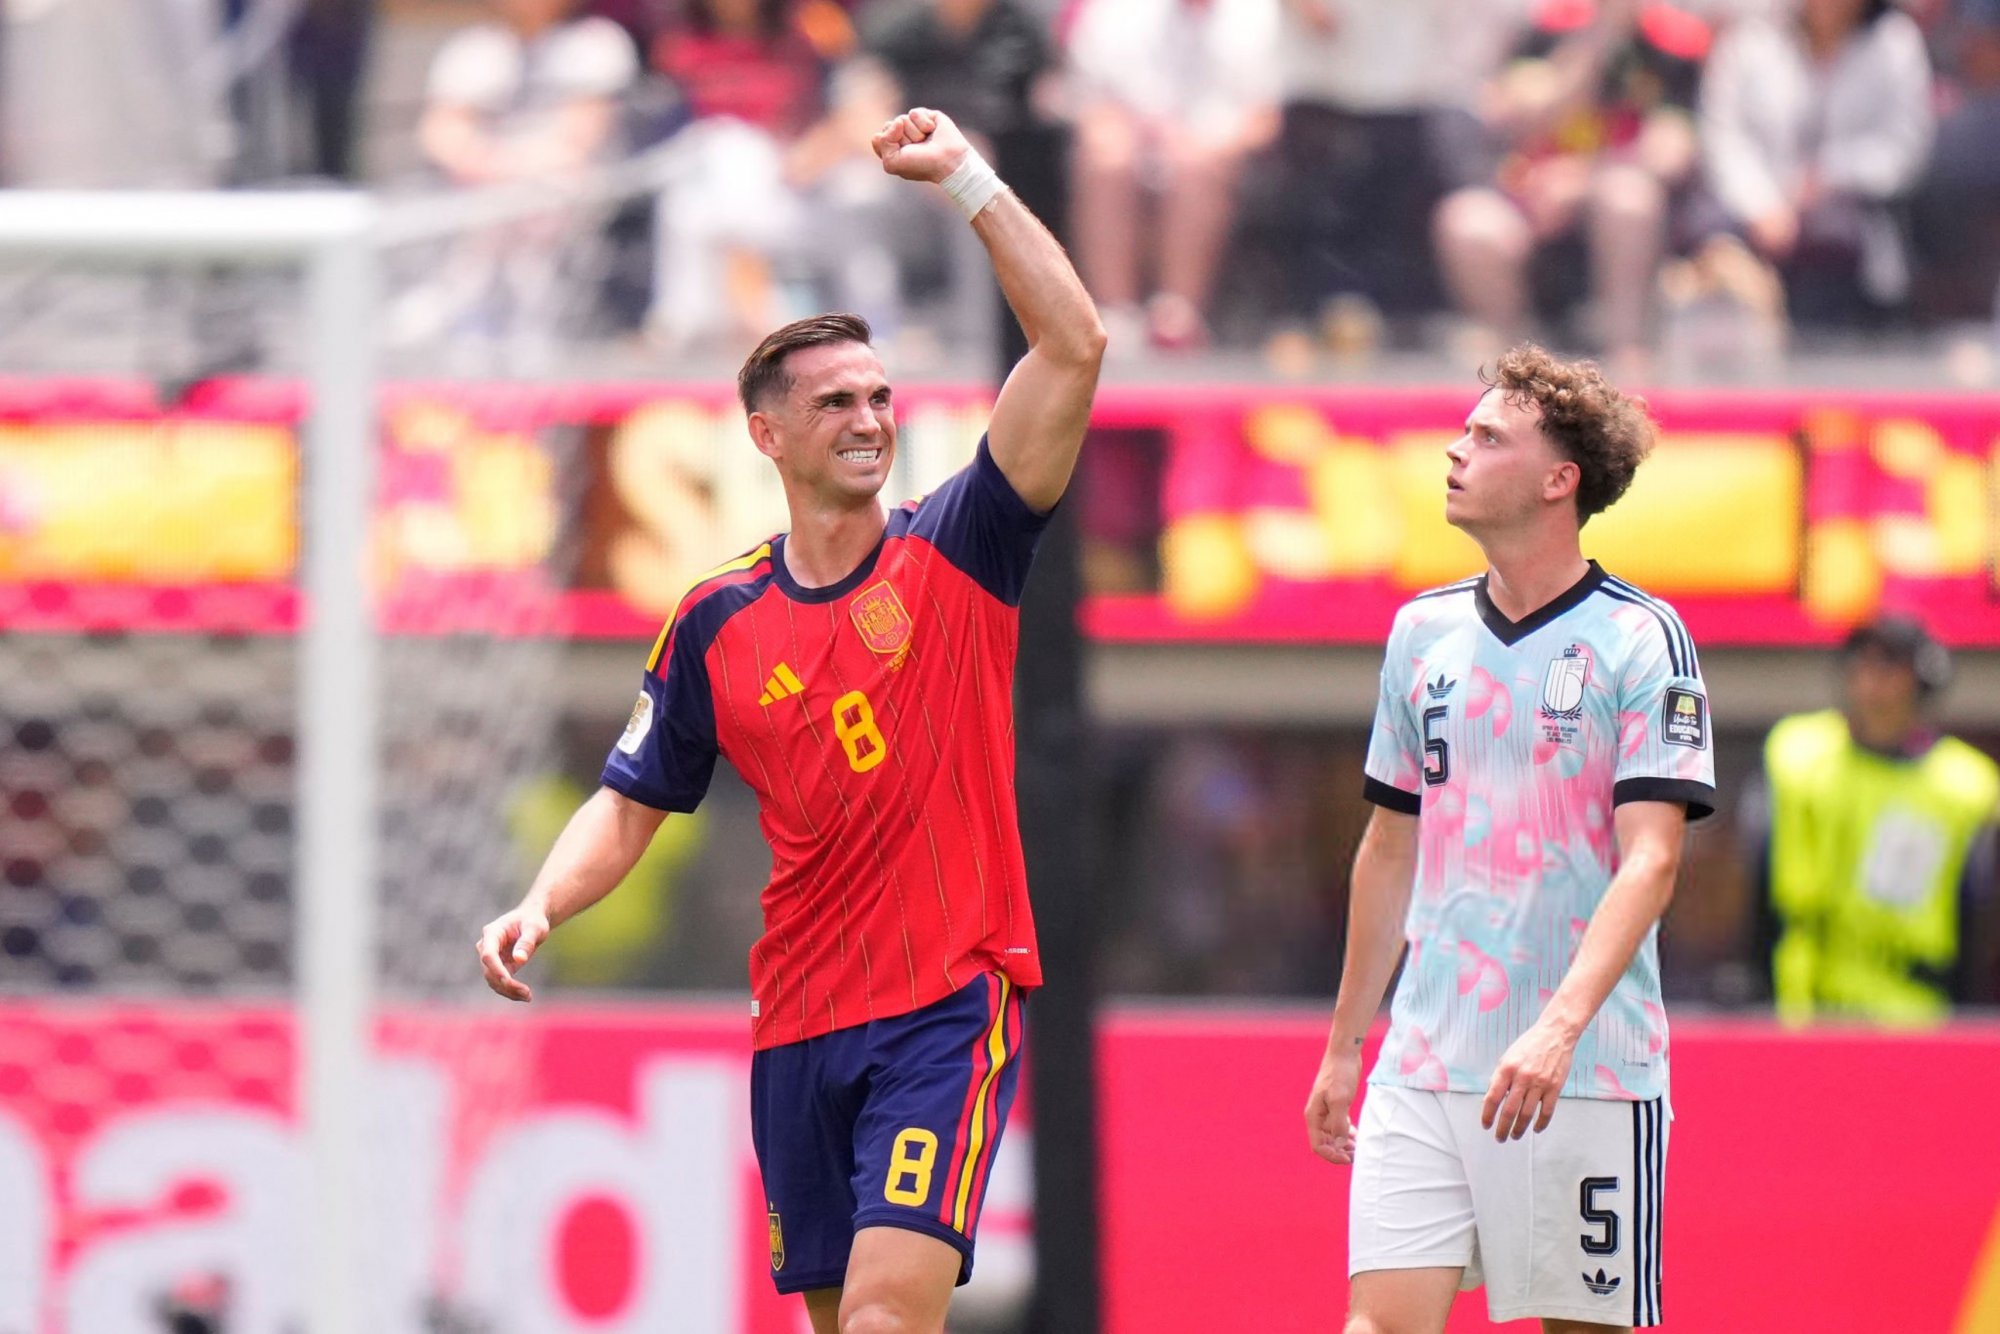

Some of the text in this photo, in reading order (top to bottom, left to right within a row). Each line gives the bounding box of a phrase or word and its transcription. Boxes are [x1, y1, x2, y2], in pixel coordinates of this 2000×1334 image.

[832, 690, 886, 773] 8
[1423, 705, 1450, 788] 5
[884, 1127, 938, 1207] 8
[1580, 1176, 1621, 1258] 5
